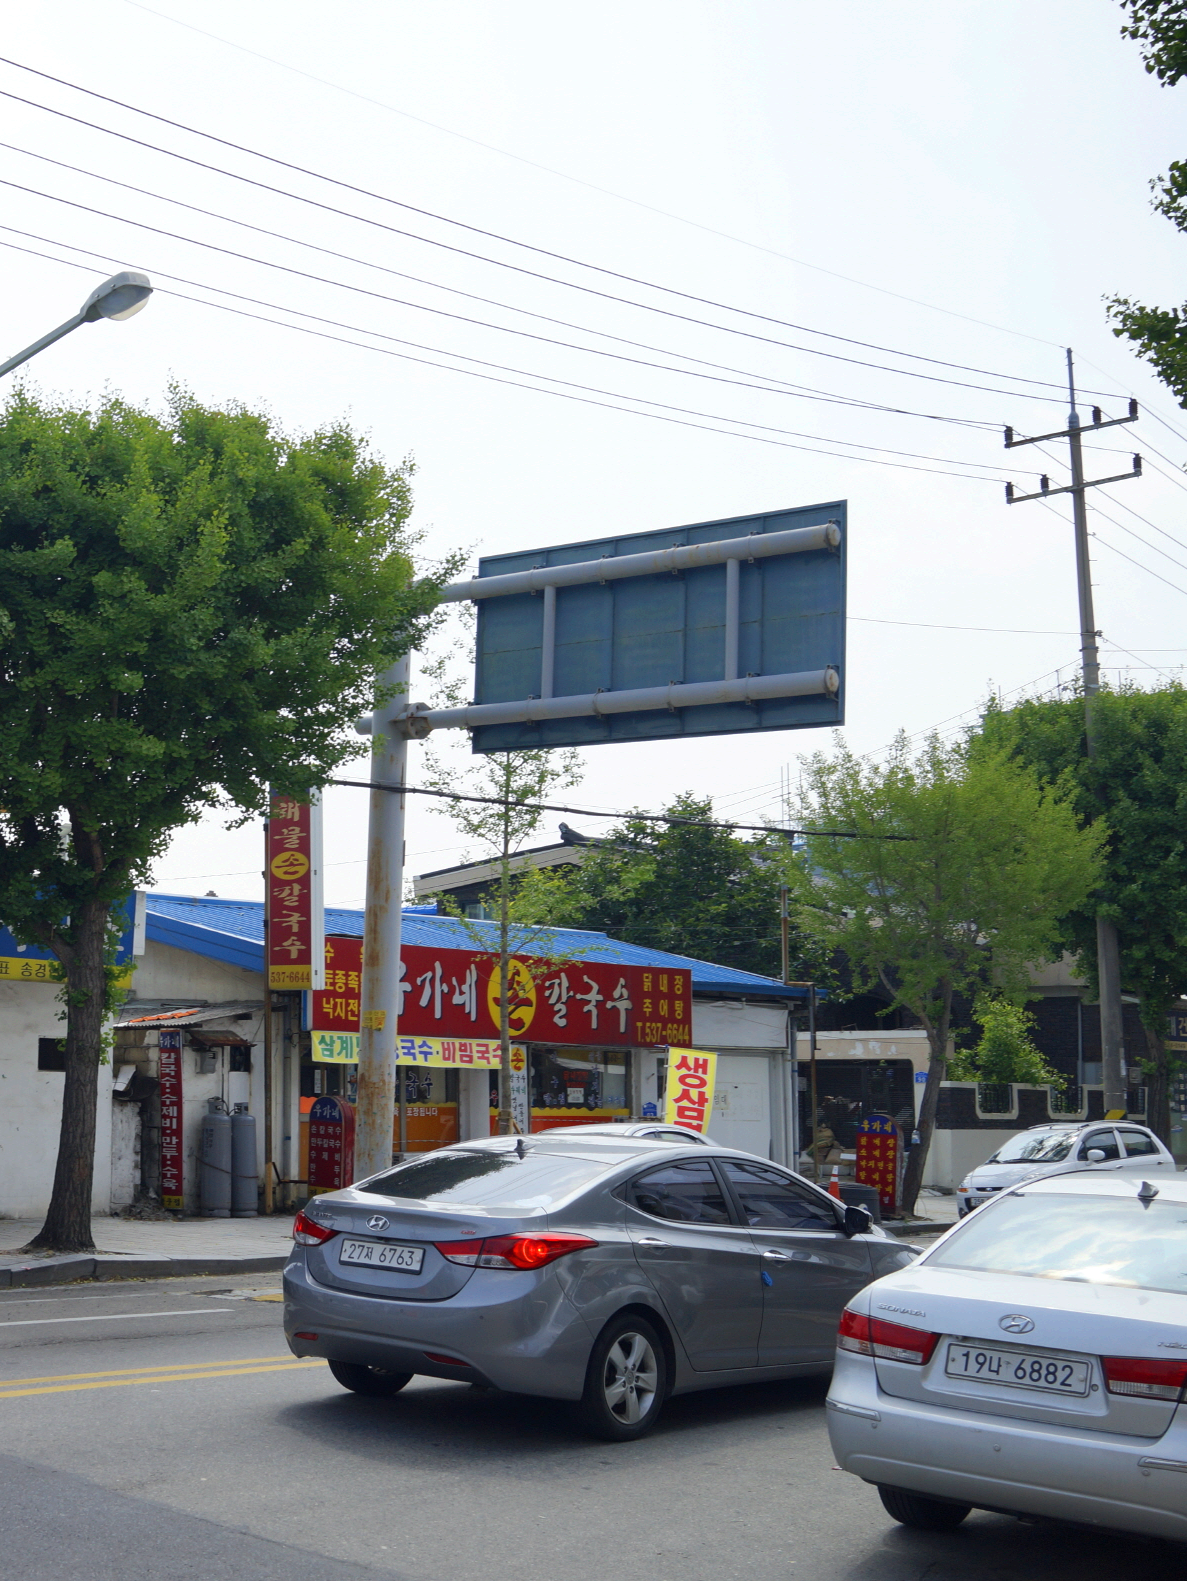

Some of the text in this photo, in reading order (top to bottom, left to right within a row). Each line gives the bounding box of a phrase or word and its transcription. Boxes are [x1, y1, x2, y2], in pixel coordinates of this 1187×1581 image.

[270, 971, 311, 984] 537-6644
[324, 969, 363, 993] 토종족
[643, 973, 684, 995] 닭내장
[322, 997, 361, 1021] 낙지전
[544, 972, 633, 1034] 칼국수
[643, 999, 684, 1019] 추어탕
[636, 1022, 690, 1044] T.537-6644
[318, 1034, 361, 1060] 삼계
[161, 1052, 178, 1089] 칼국수
[162, 1094, 179, 1130] 수제비
[861, 1119, 893, 1133] 우가네
[162, 1136, 180, 1161] 만두
[162, 1167, 180, 1191] 수육
[347, 1243, 414, 1267] 27저 6763
[877, 1302, 926, 1318] SONATA
[962, 1350, 1074, 1388] 19나 6882
